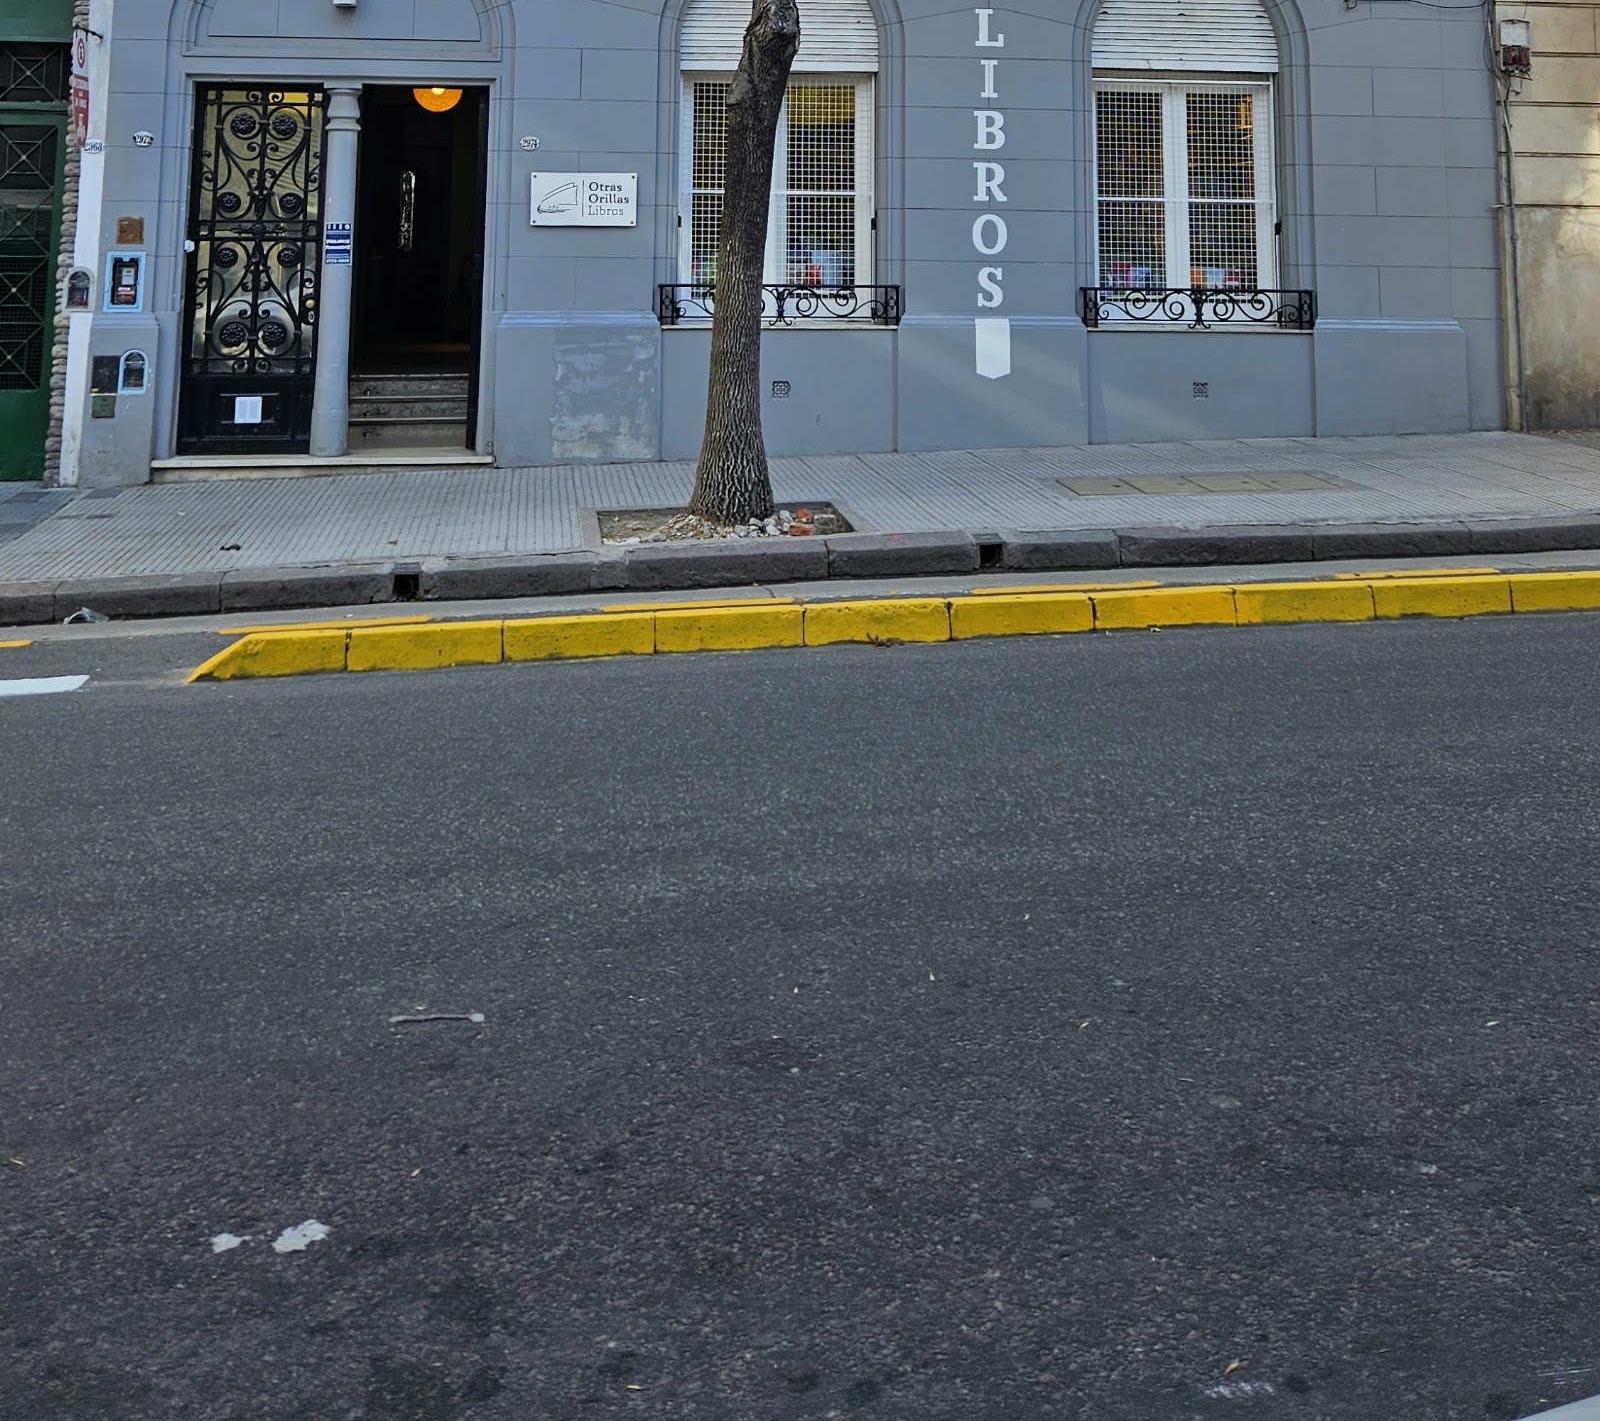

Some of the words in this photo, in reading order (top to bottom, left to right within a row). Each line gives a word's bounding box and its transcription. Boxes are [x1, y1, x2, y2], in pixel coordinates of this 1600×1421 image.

[972, 8, 1008, 307] LIBROS
[588, 182, 623, 192] Otras
[588, 193, 630, 204] Orillas
[588, 205, 624, 216] Libros
